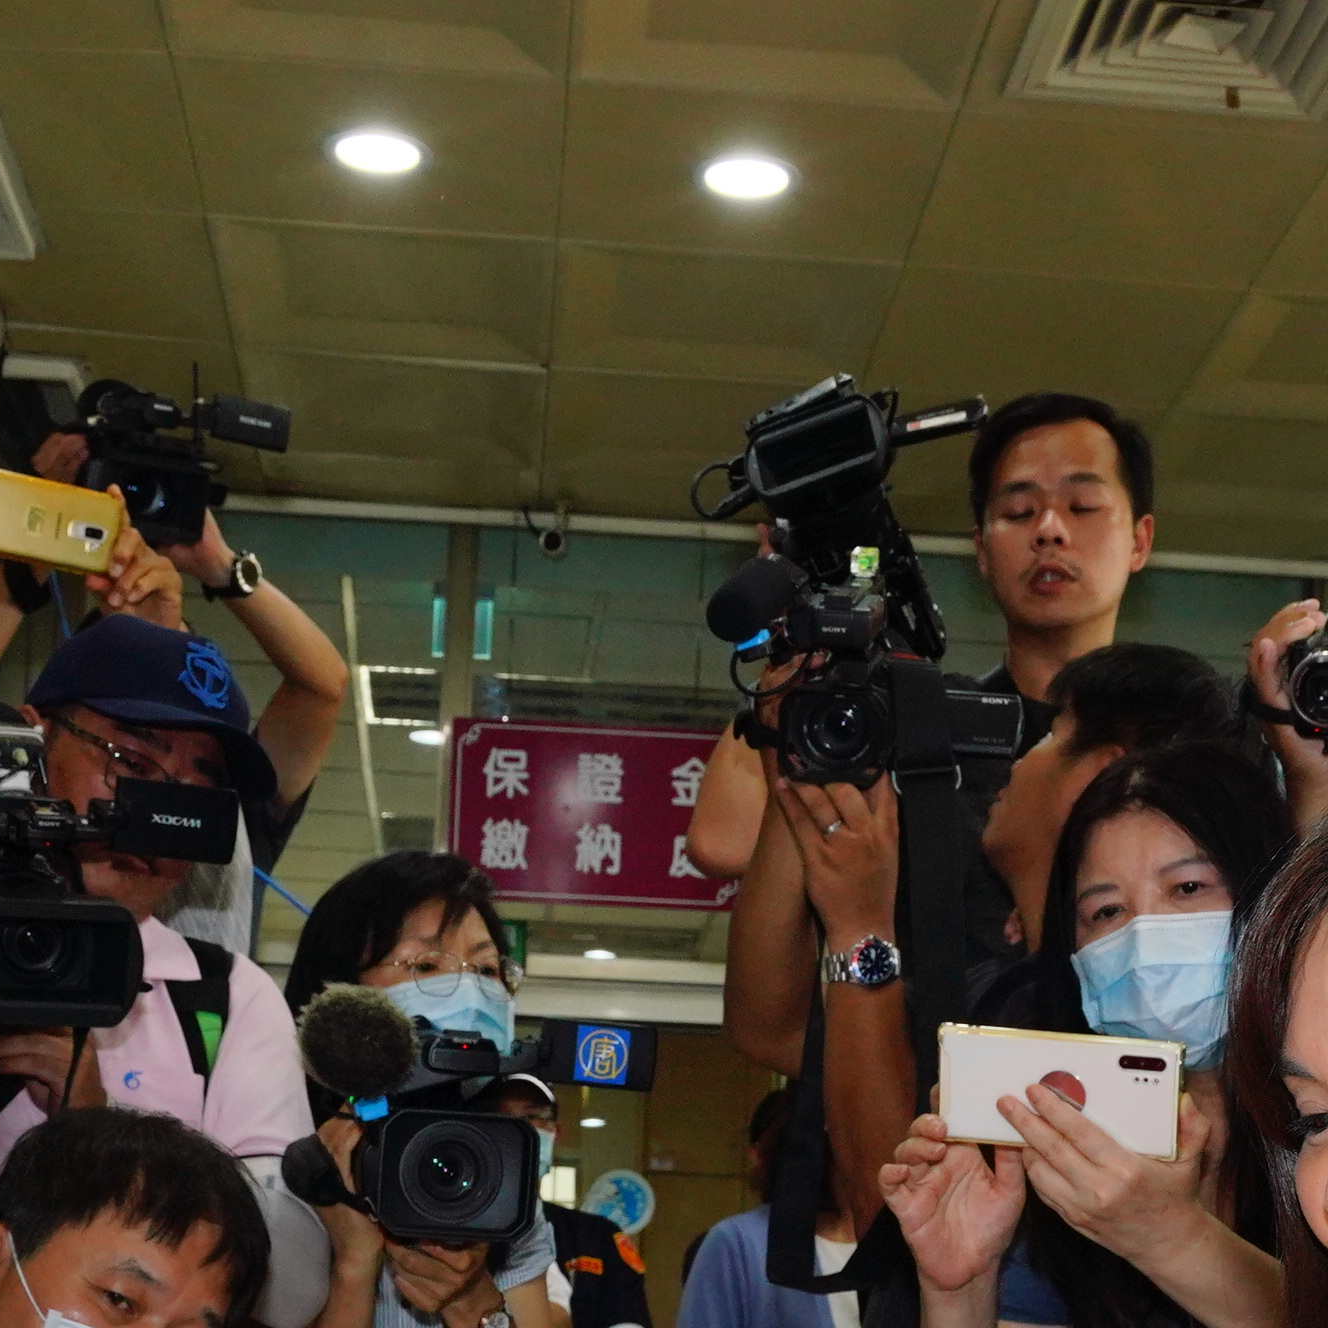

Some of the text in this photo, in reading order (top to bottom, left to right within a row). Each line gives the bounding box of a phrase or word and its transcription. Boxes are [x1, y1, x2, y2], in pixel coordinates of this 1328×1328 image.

[821, 626, 847, 634] SONY
[981, 697, 1011, 706] SONY
[482, 746, 706, 807] 保證金
